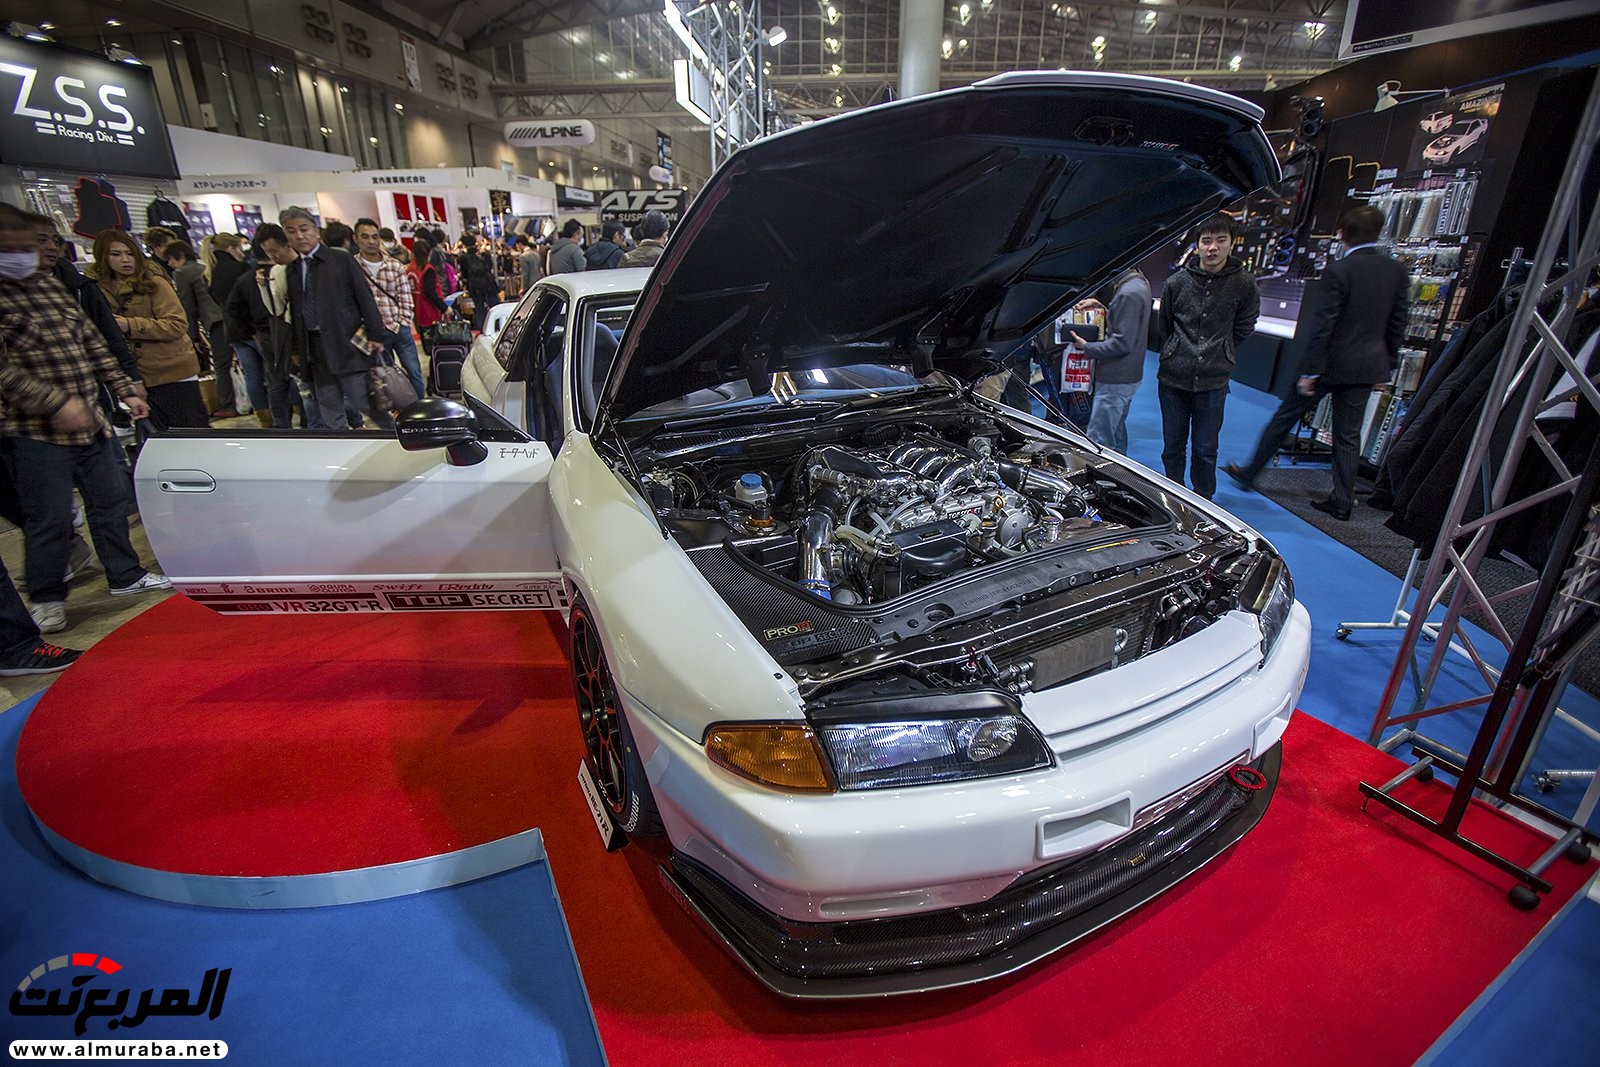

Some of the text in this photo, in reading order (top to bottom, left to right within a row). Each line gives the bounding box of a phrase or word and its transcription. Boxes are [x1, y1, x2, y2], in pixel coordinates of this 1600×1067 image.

[0, 62, 146, 135] Z.S.S.
[57, 124, 117, 144] Racing Div.
[532, 125, 584, 138] ALPINE
[601, 190, 682, 211] ATS
[618, 213, 678, 222] SUSPON
[500, 447, 540, 459] モーターヘッド
[438, 583, 495, 591] GReddy
[274, 600, 384, 612] VR32GT-R
[396, 593, 543, 606] TOP SECRET
